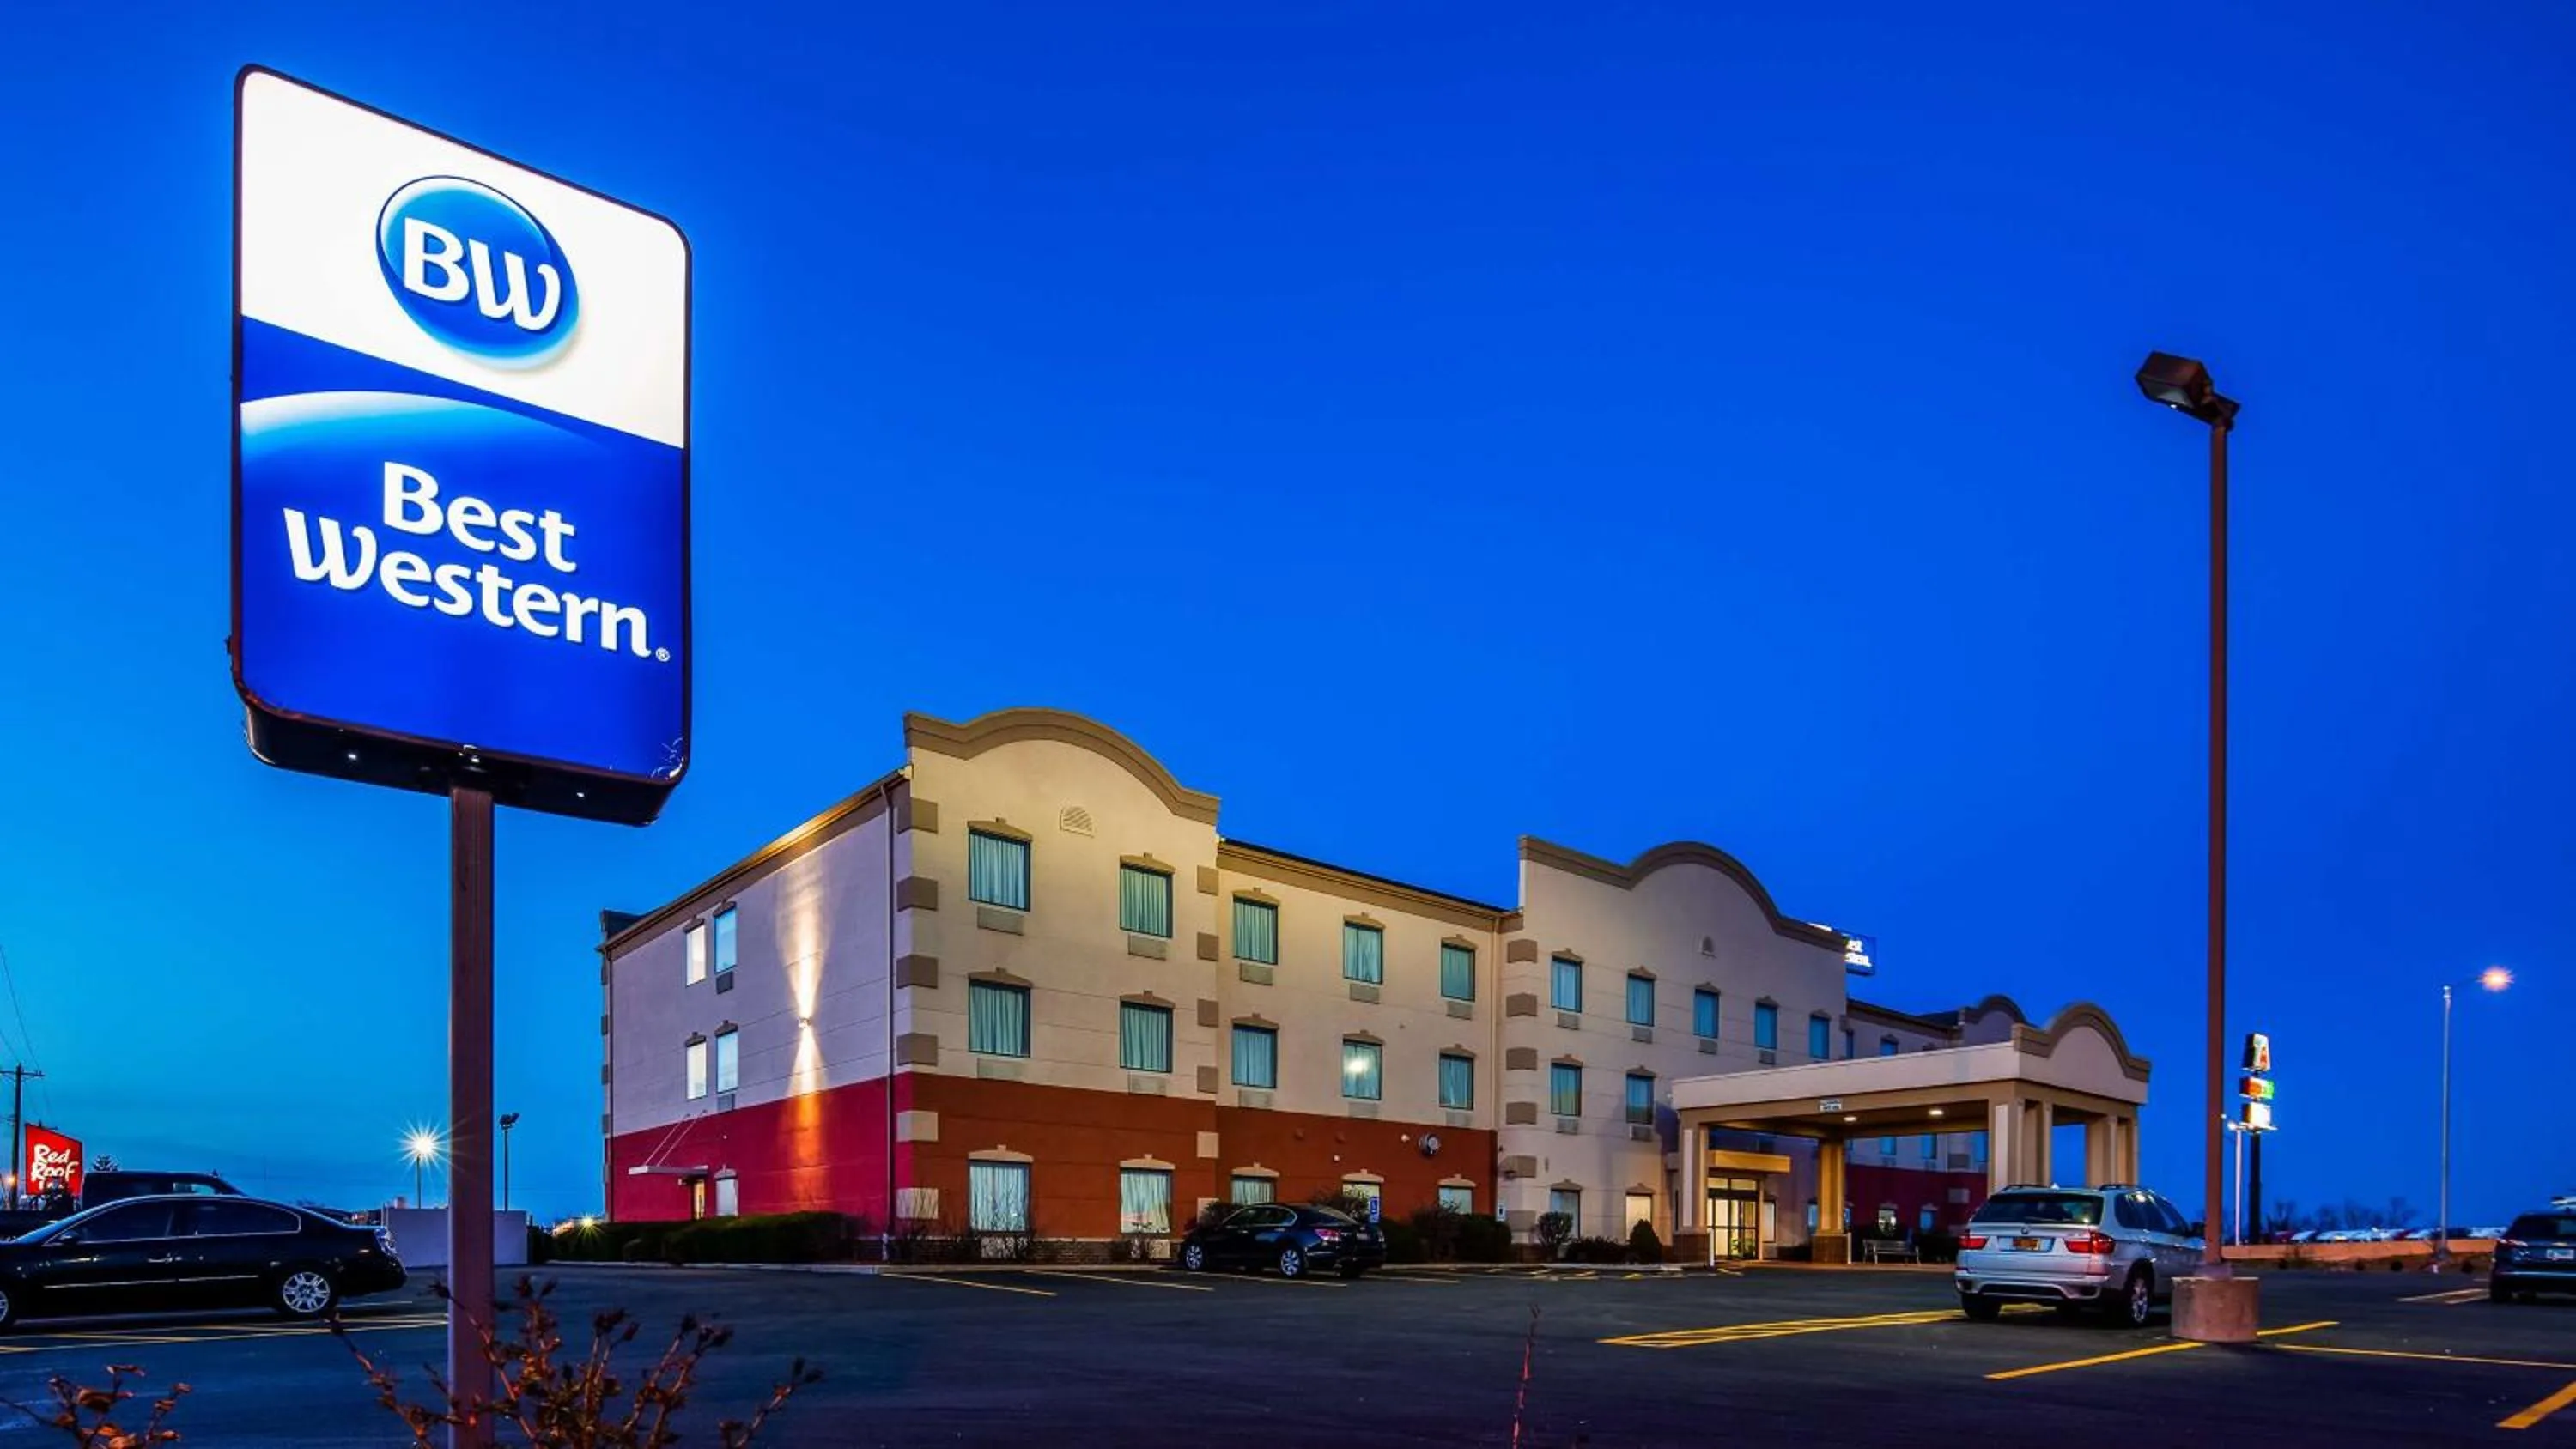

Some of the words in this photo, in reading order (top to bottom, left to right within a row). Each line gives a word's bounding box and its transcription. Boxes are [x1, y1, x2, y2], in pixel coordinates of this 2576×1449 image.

[404, 217, 561, 330] BW
[384, 461, 577, 573] Best
[283, 508, 651, 658] Western
[31, 1161, 79, 1182] Roof
[34, 1143, 70, 1164] Red
